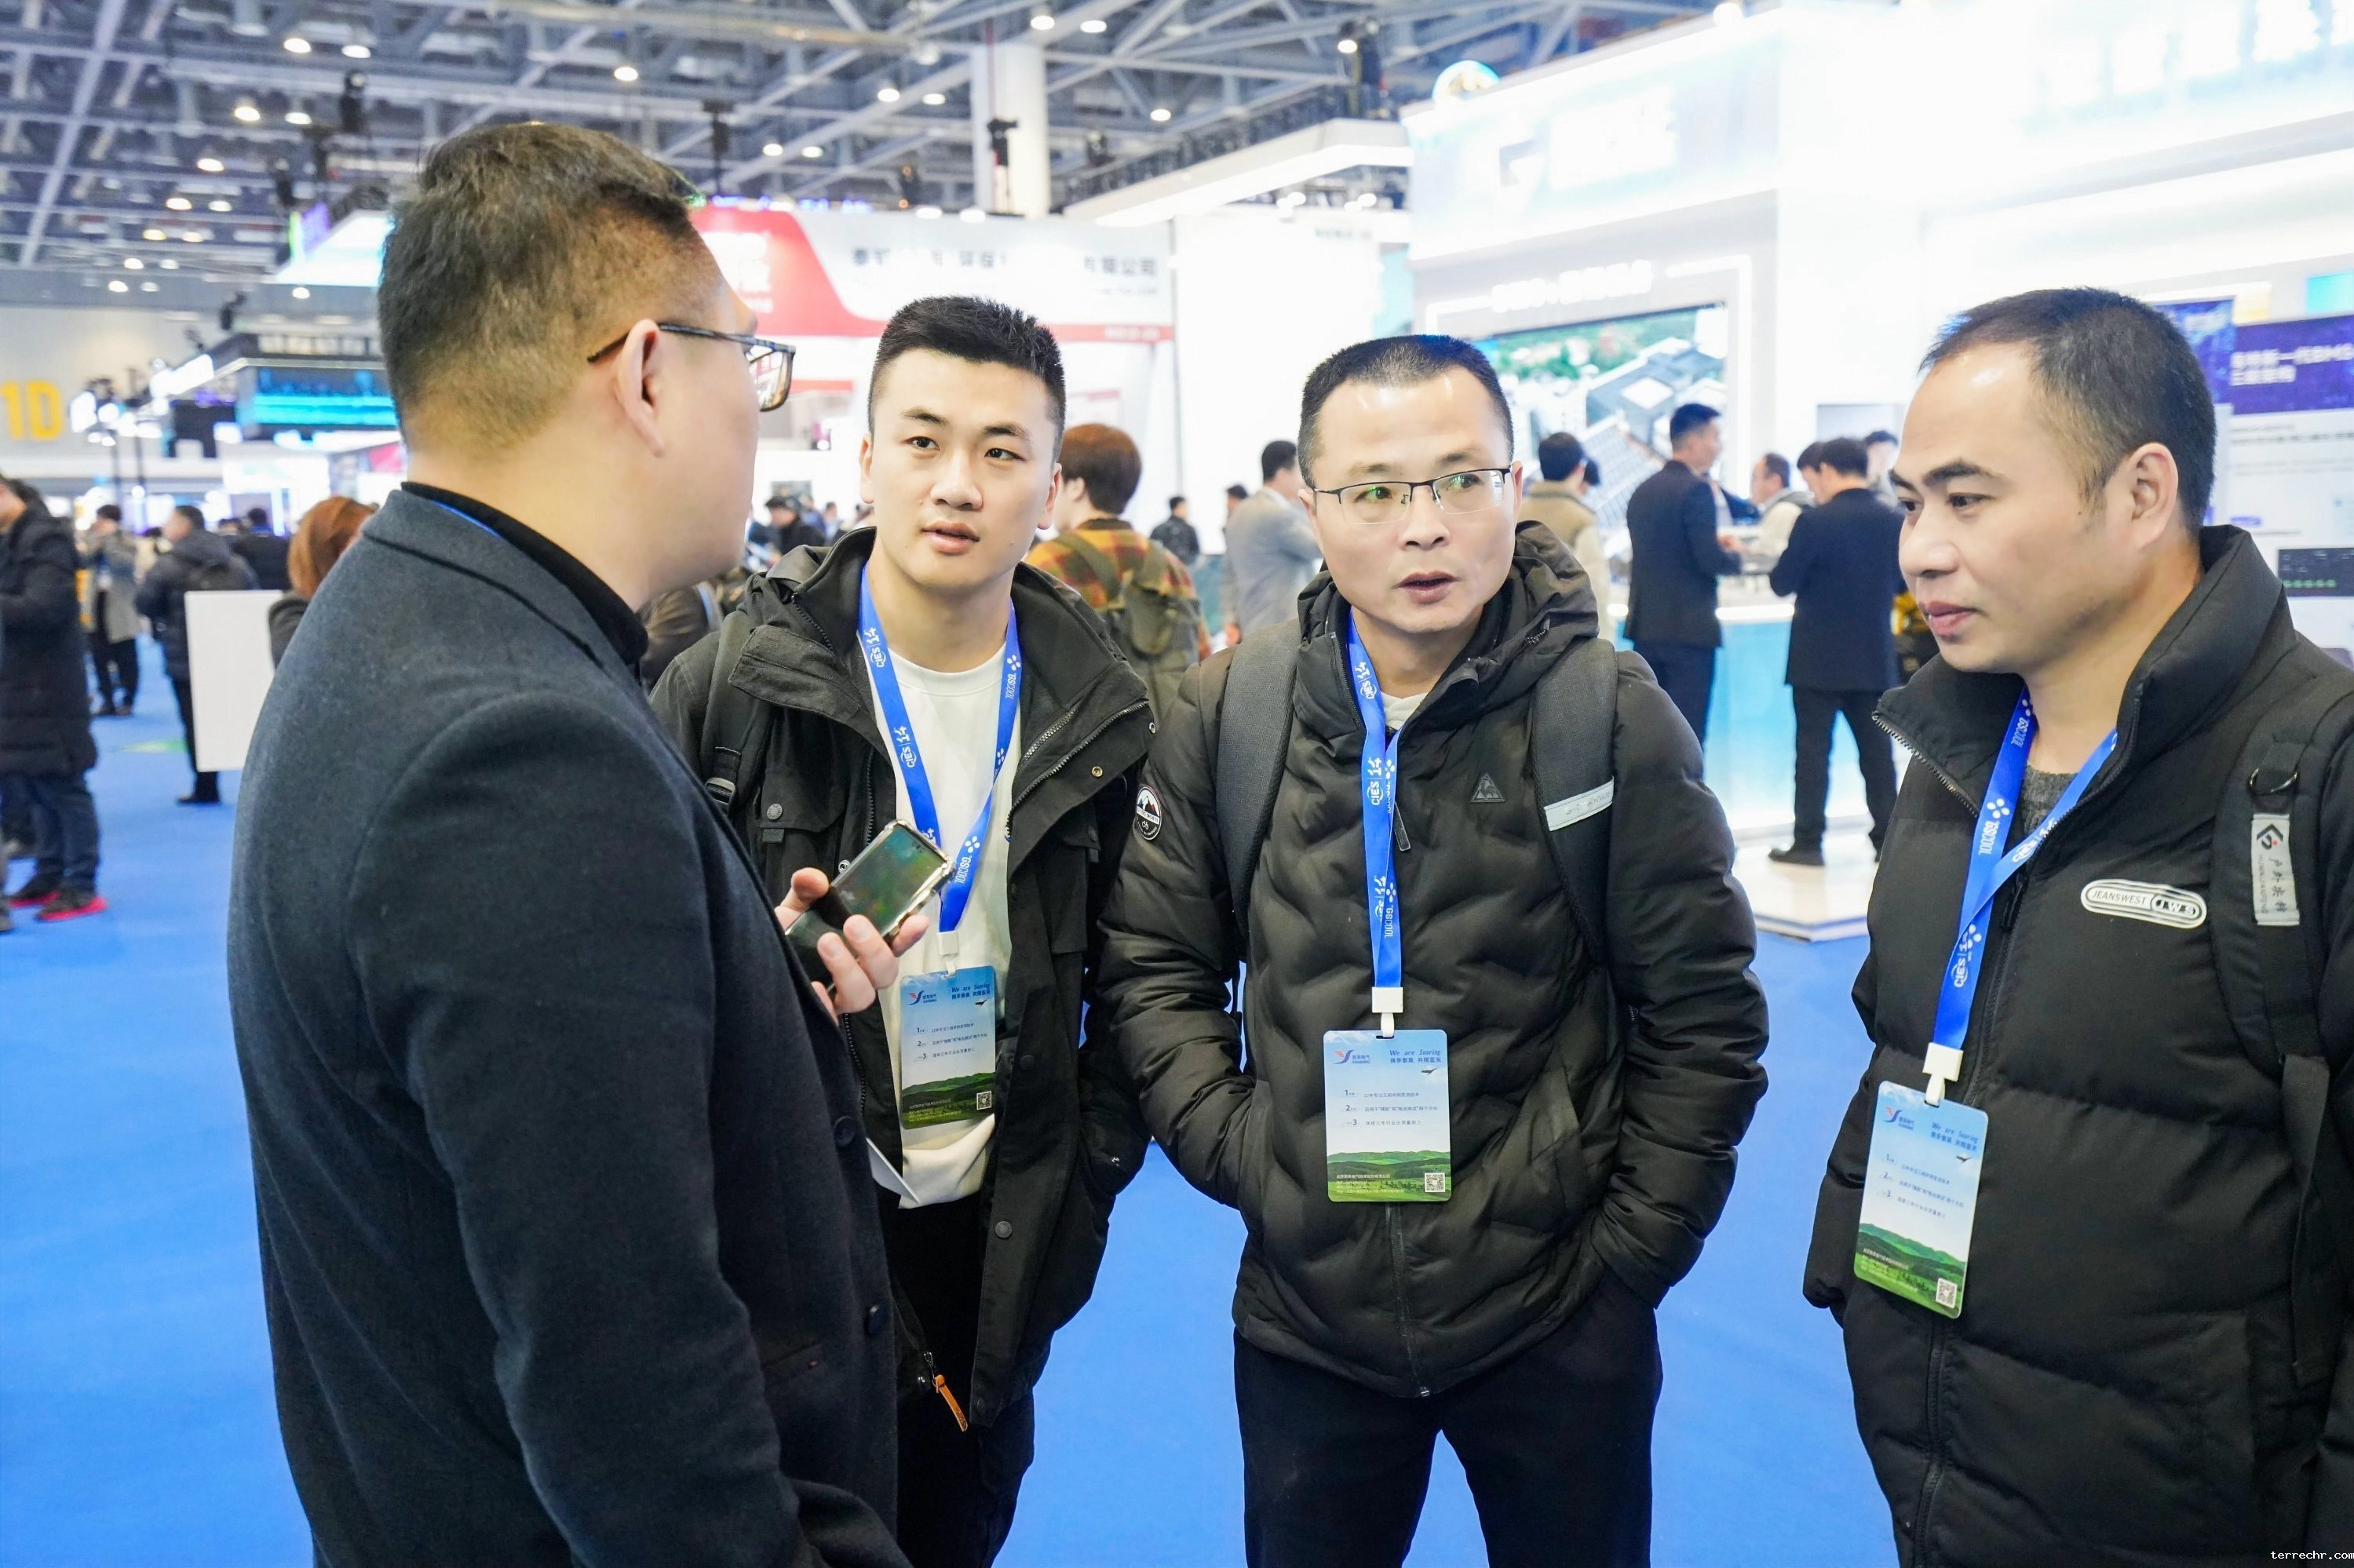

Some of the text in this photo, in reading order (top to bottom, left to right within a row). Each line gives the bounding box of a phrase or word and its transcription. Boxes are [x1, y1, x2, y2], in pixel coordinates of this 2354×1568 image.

[870, 647, 886, 668] CIES
[1360, 680, 1377, 699] CIES
[901, 746, 917, 768] CIES
[1367, 781, 1384, 806] CIES
[1978, 820, 1999, 855] GSCOOL
[954, 856, 972, 884] GSCOOL
[2091, 890, 2148, 905] JEANSWEST
[1384, 907, 1394, 939] GSCOOL
[1952, 957, 1968, 988] CIES
